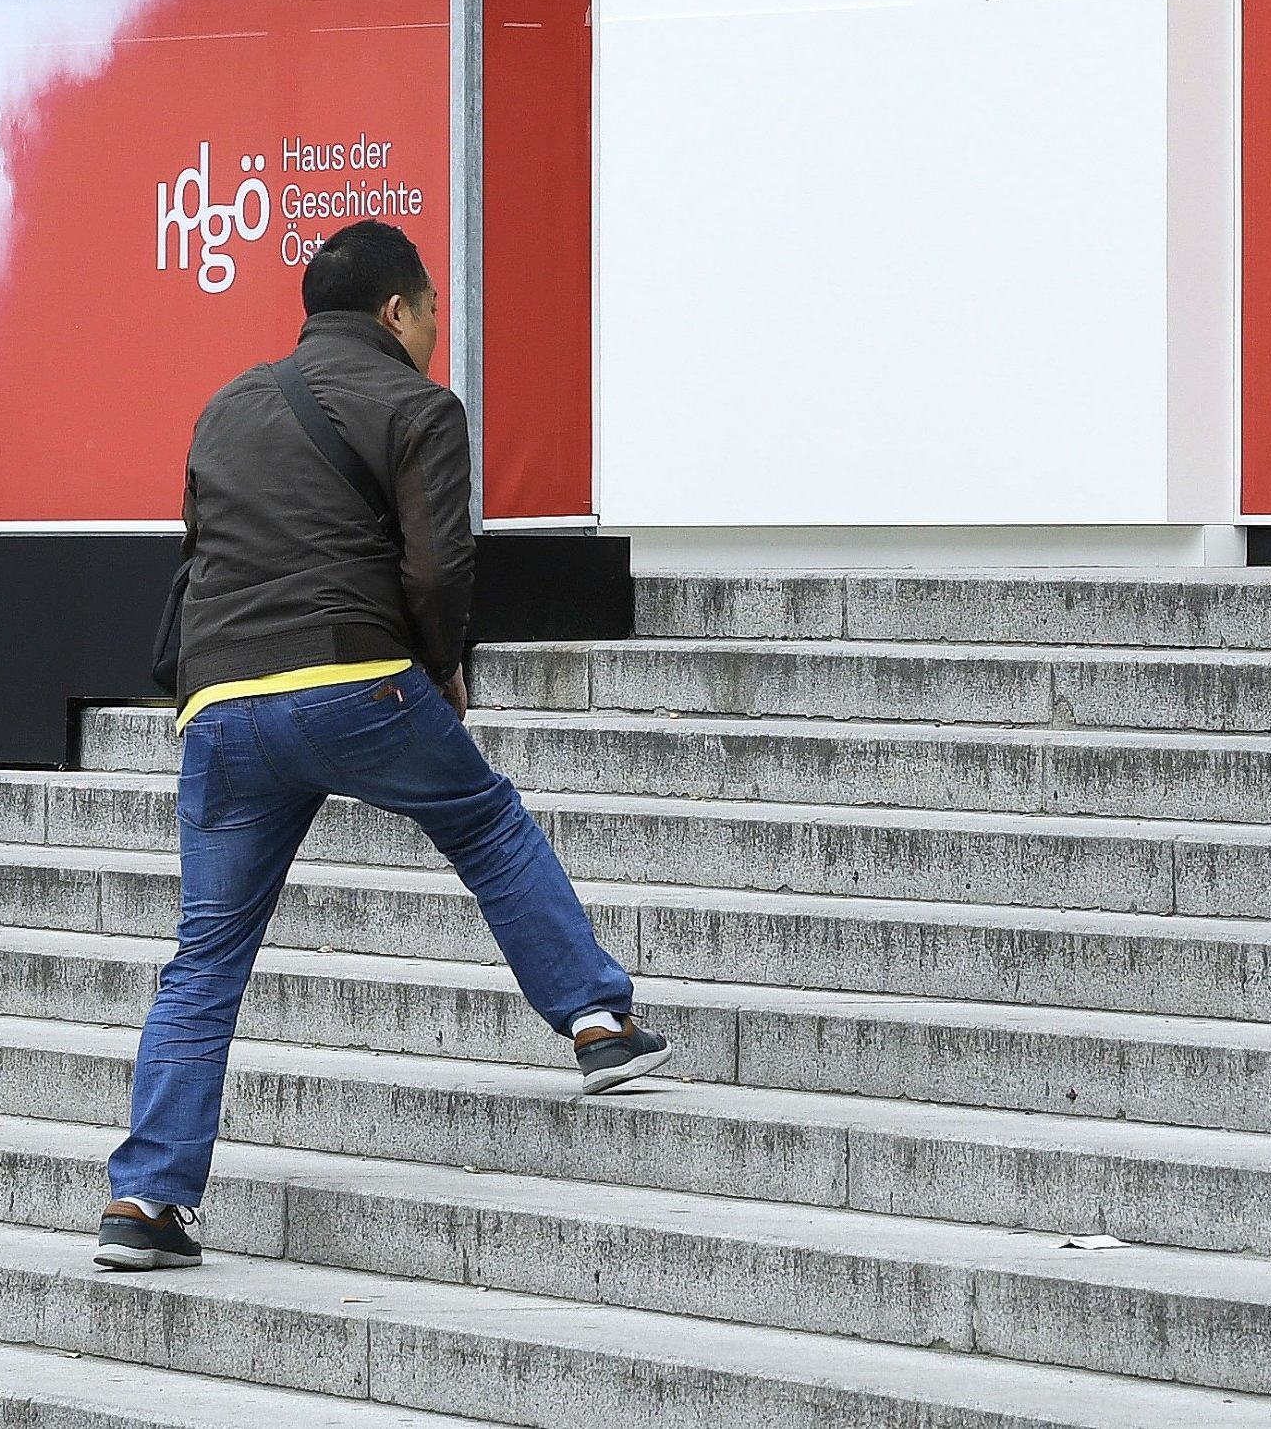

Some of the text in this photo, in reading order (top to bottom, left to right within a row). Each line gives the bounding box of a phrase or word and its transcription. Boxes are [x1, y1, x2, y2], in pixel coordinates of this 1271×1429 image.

[283, 133, 392, 172] Haus der
[281, 179, 422, 219] Geschichte
